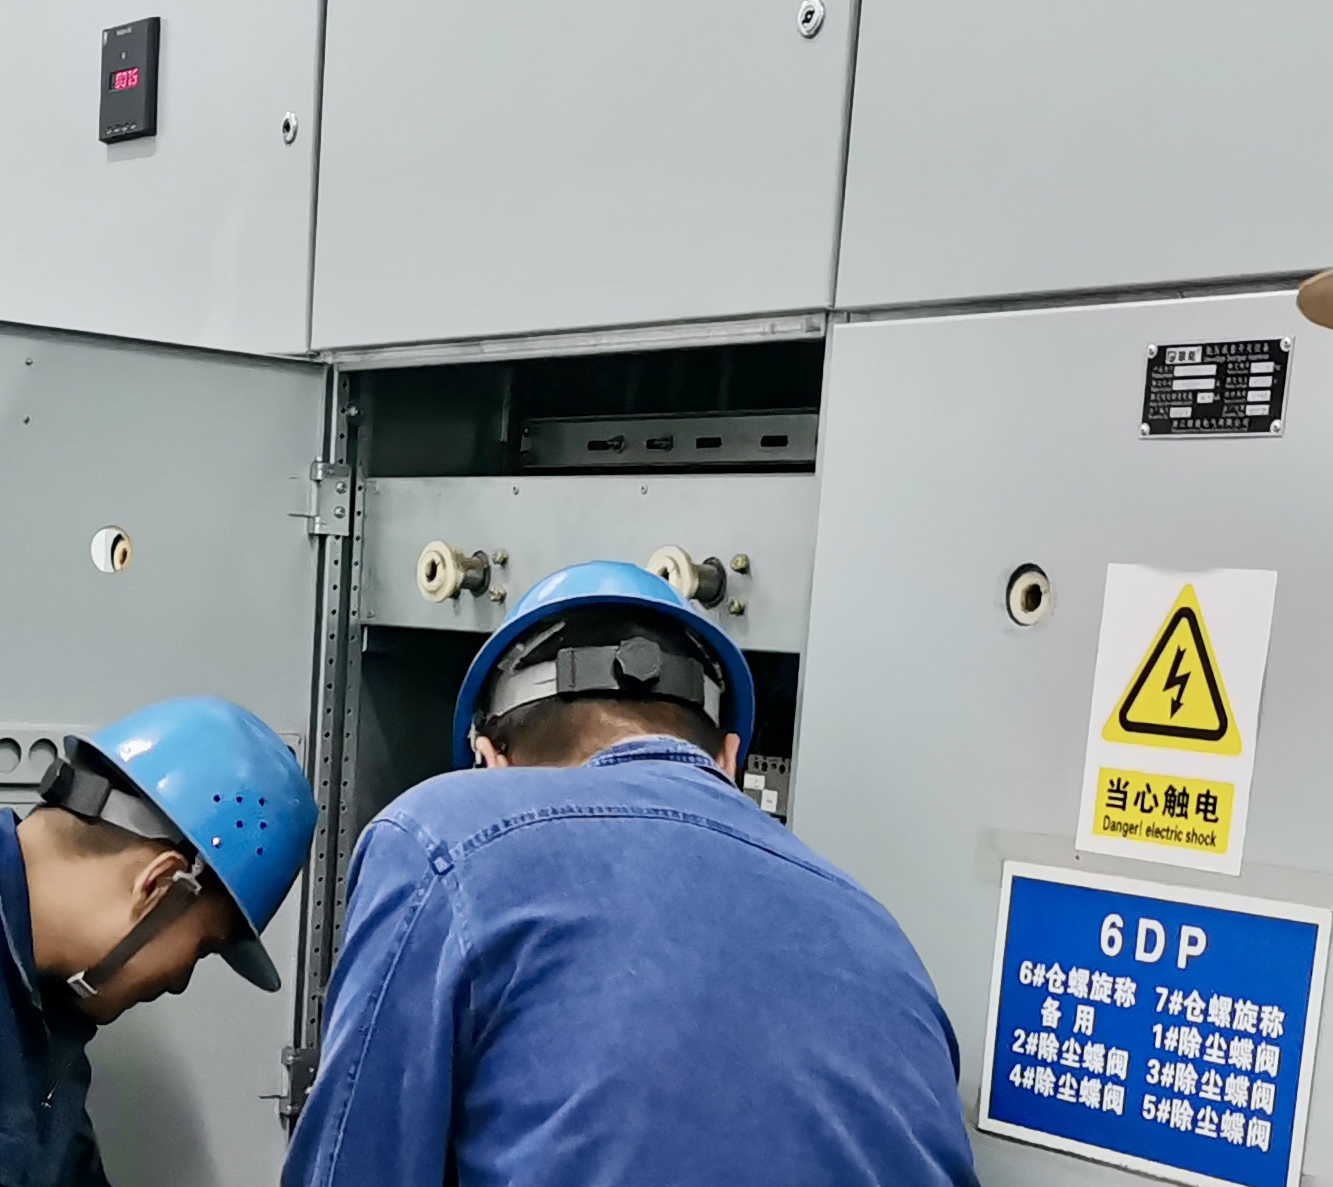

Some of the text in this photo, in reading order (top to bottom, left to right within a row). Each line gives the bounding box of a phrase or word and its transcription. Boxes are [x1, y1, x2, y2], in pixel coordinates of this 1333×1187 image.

[1105, 777, 1220, 824] 当心触电
[1144, 823, 1184, 843] electric
[1184, 829, 1218, 848] shock
[1018, 959, 1137, 1009] 6#仓螺旋称
[1154, 986, 1286, 1039] 7#仓螺旋称
